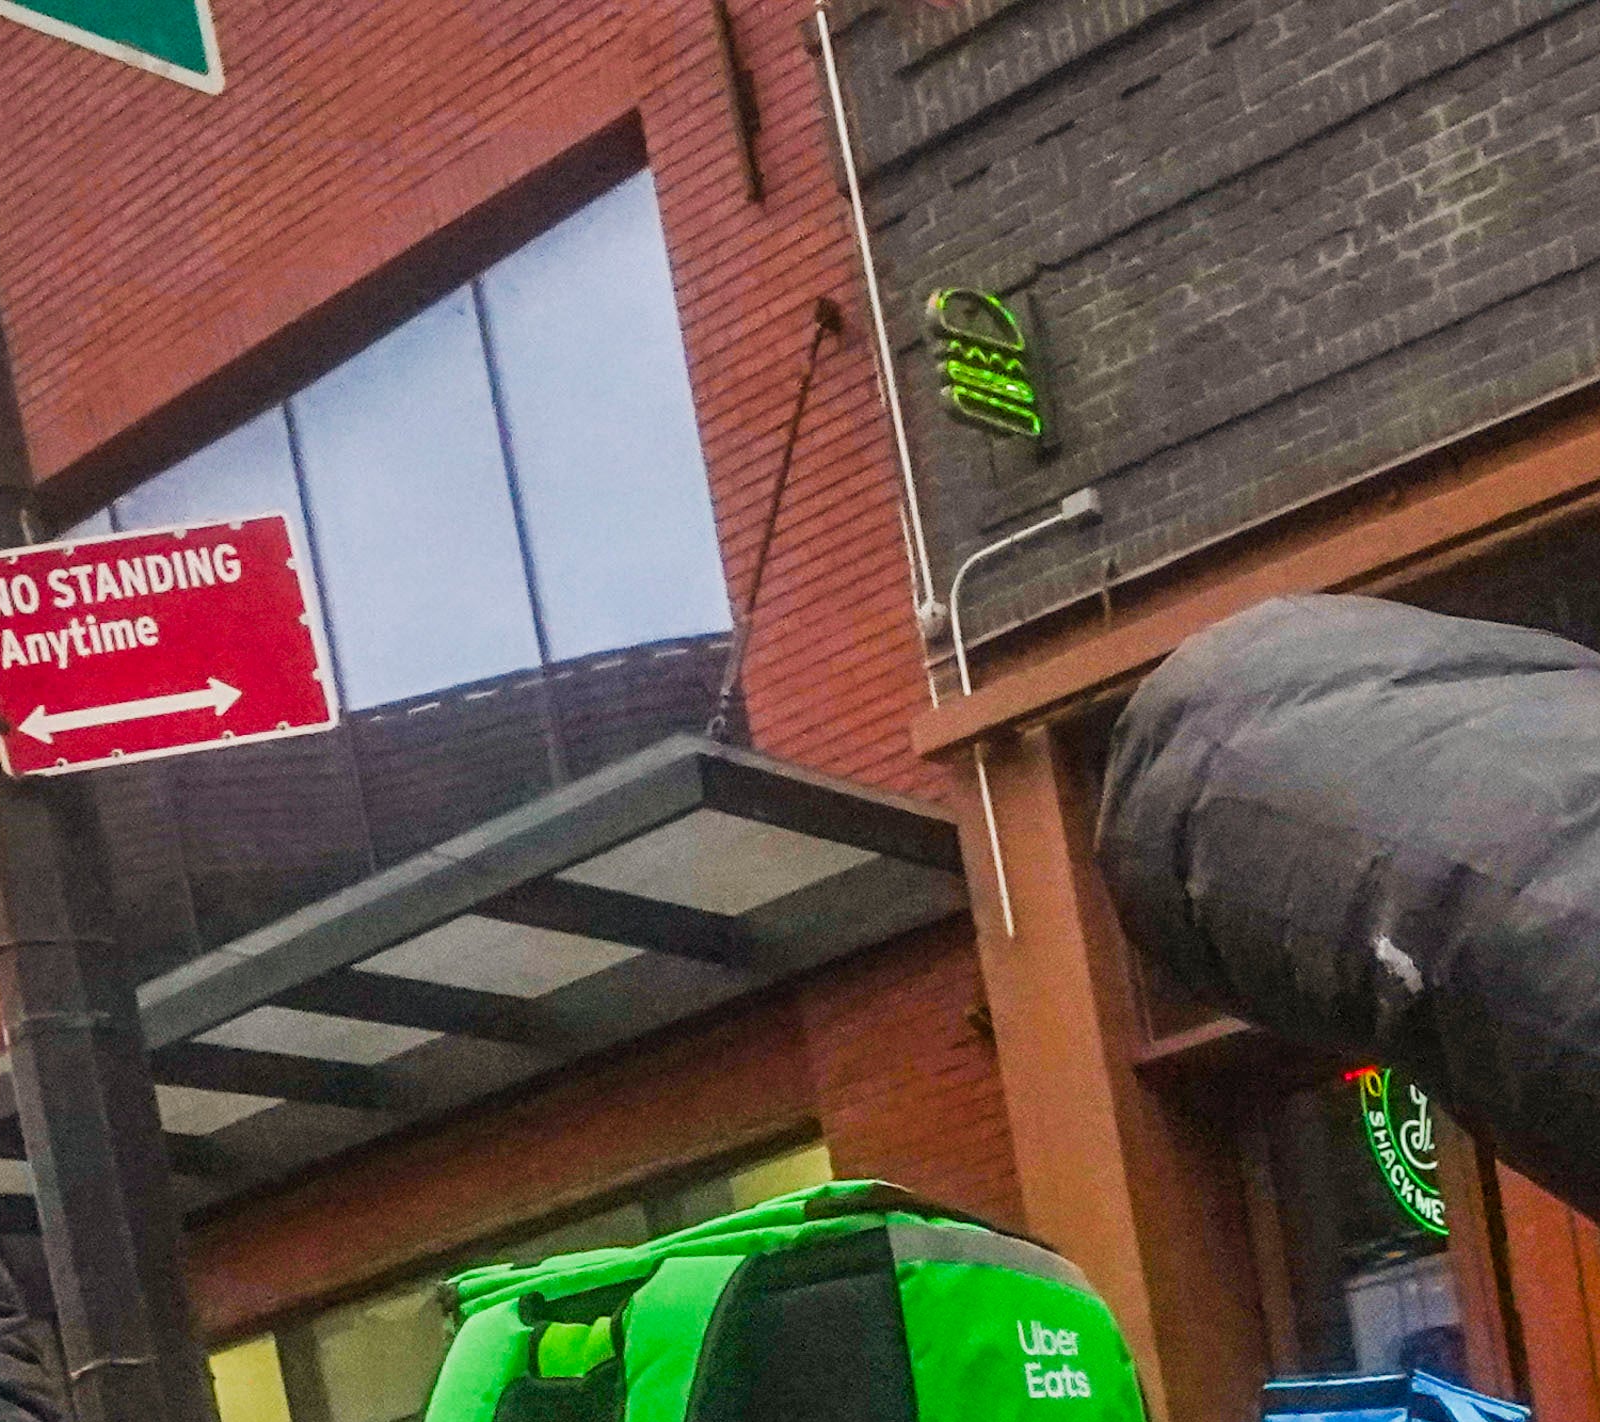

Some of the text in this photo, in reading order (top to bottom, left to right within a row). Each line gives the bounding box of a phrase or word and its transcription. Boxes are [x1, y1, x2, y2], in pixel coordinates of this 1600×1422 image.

[49, 543, 242, 610] STANDING
[0, 612, 159, 669] Anytime
[1368, 1110, 1446, 1226] SHACKME
[1016, 1319, 1079, 1356] Uber
[1024, 1361, 1092, 1399] Eats
